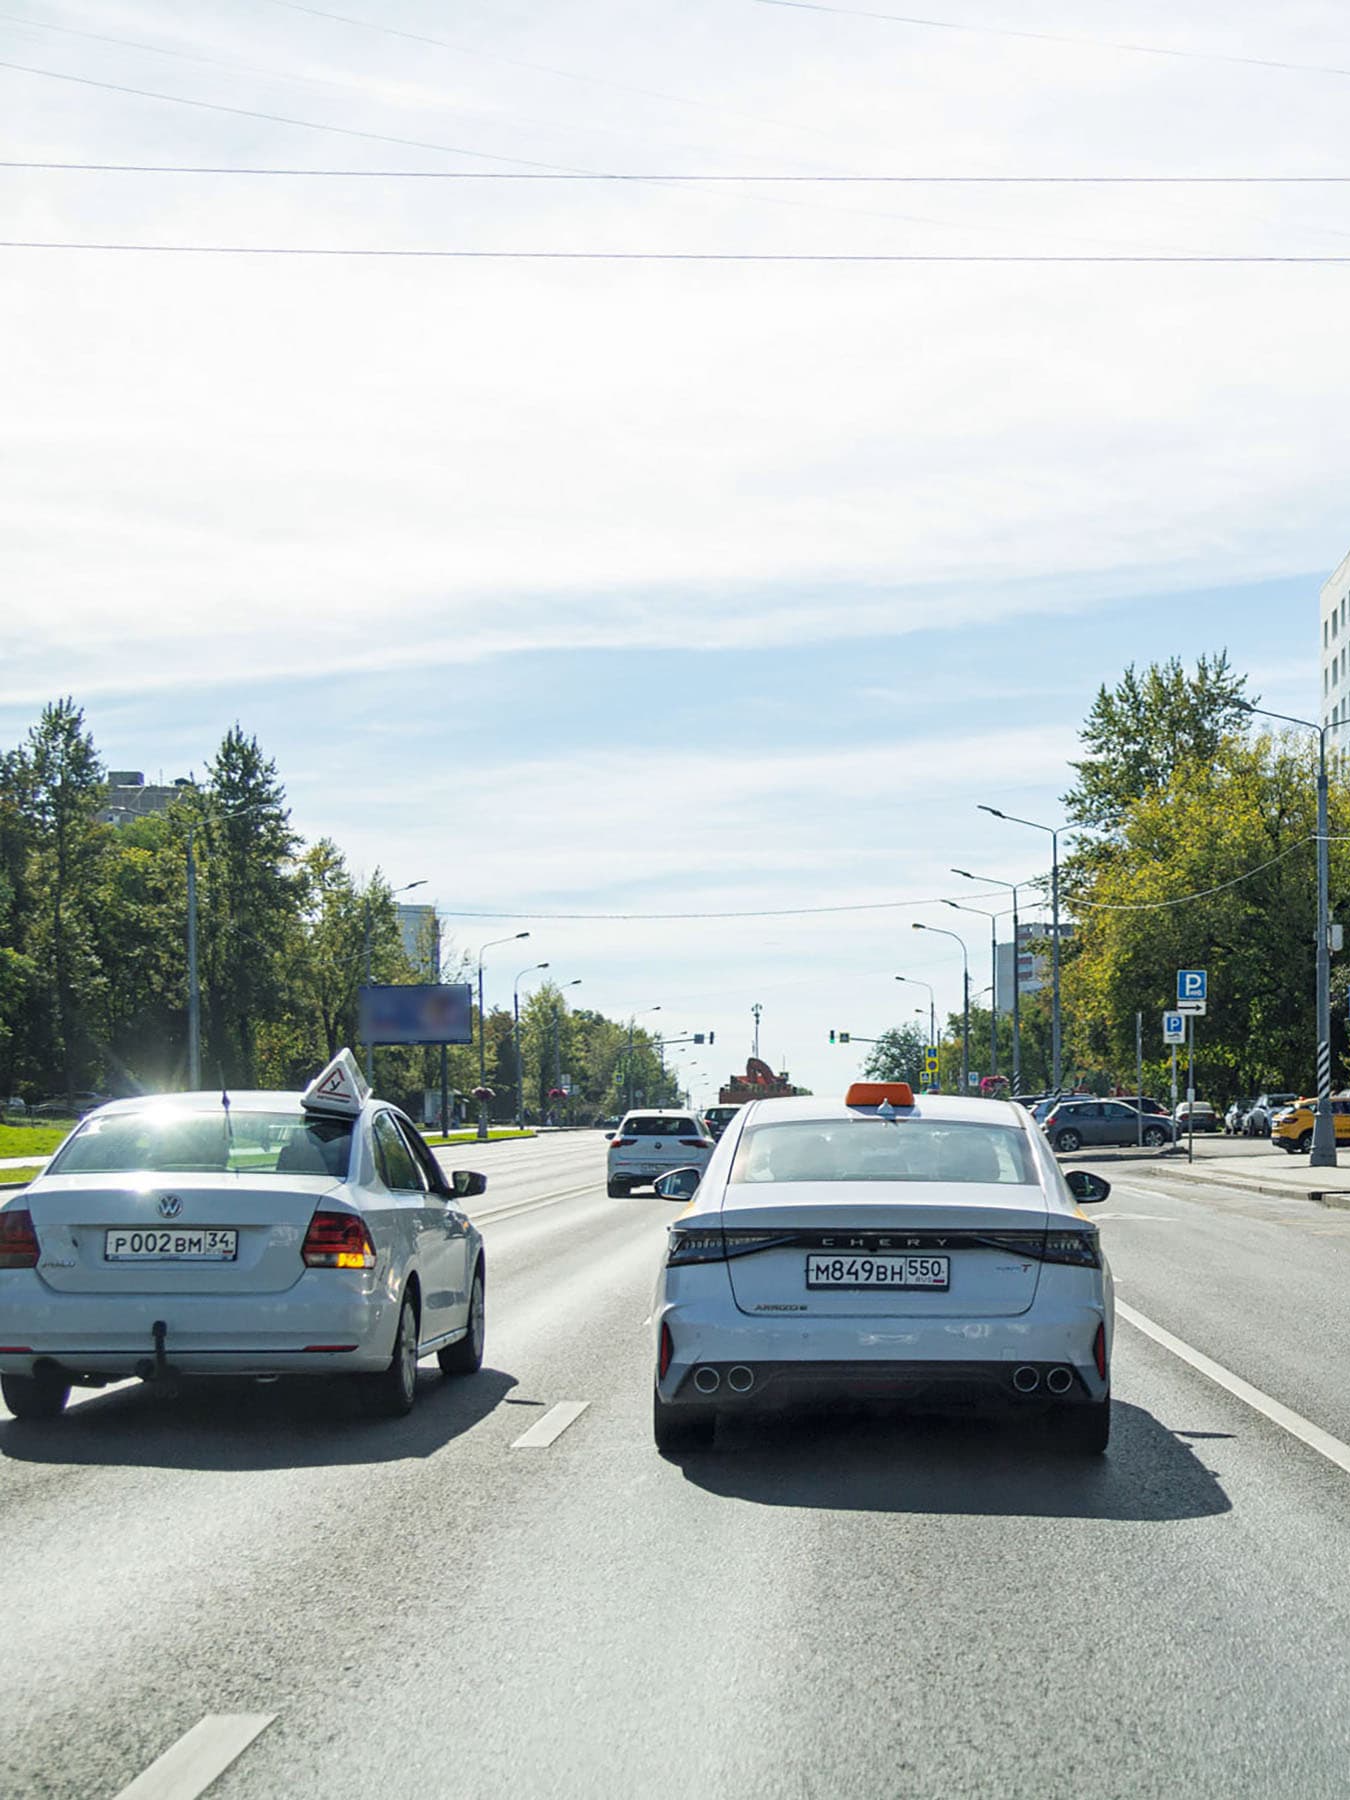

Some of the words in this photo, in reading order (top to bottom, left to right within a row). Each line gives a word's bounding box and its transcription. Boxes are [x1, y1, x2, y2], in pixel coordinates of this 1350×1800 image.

[1185, 974, 1202, 997] P
[115, 1233, 202, 1253] Р002ВМ
[208, 1233, 230, 1249] 34
[822, 1238, 947, 1247] CHERY
[815, 1260, 904, 1282] М849ВН
[908, 1260, 942, 1277] 550
